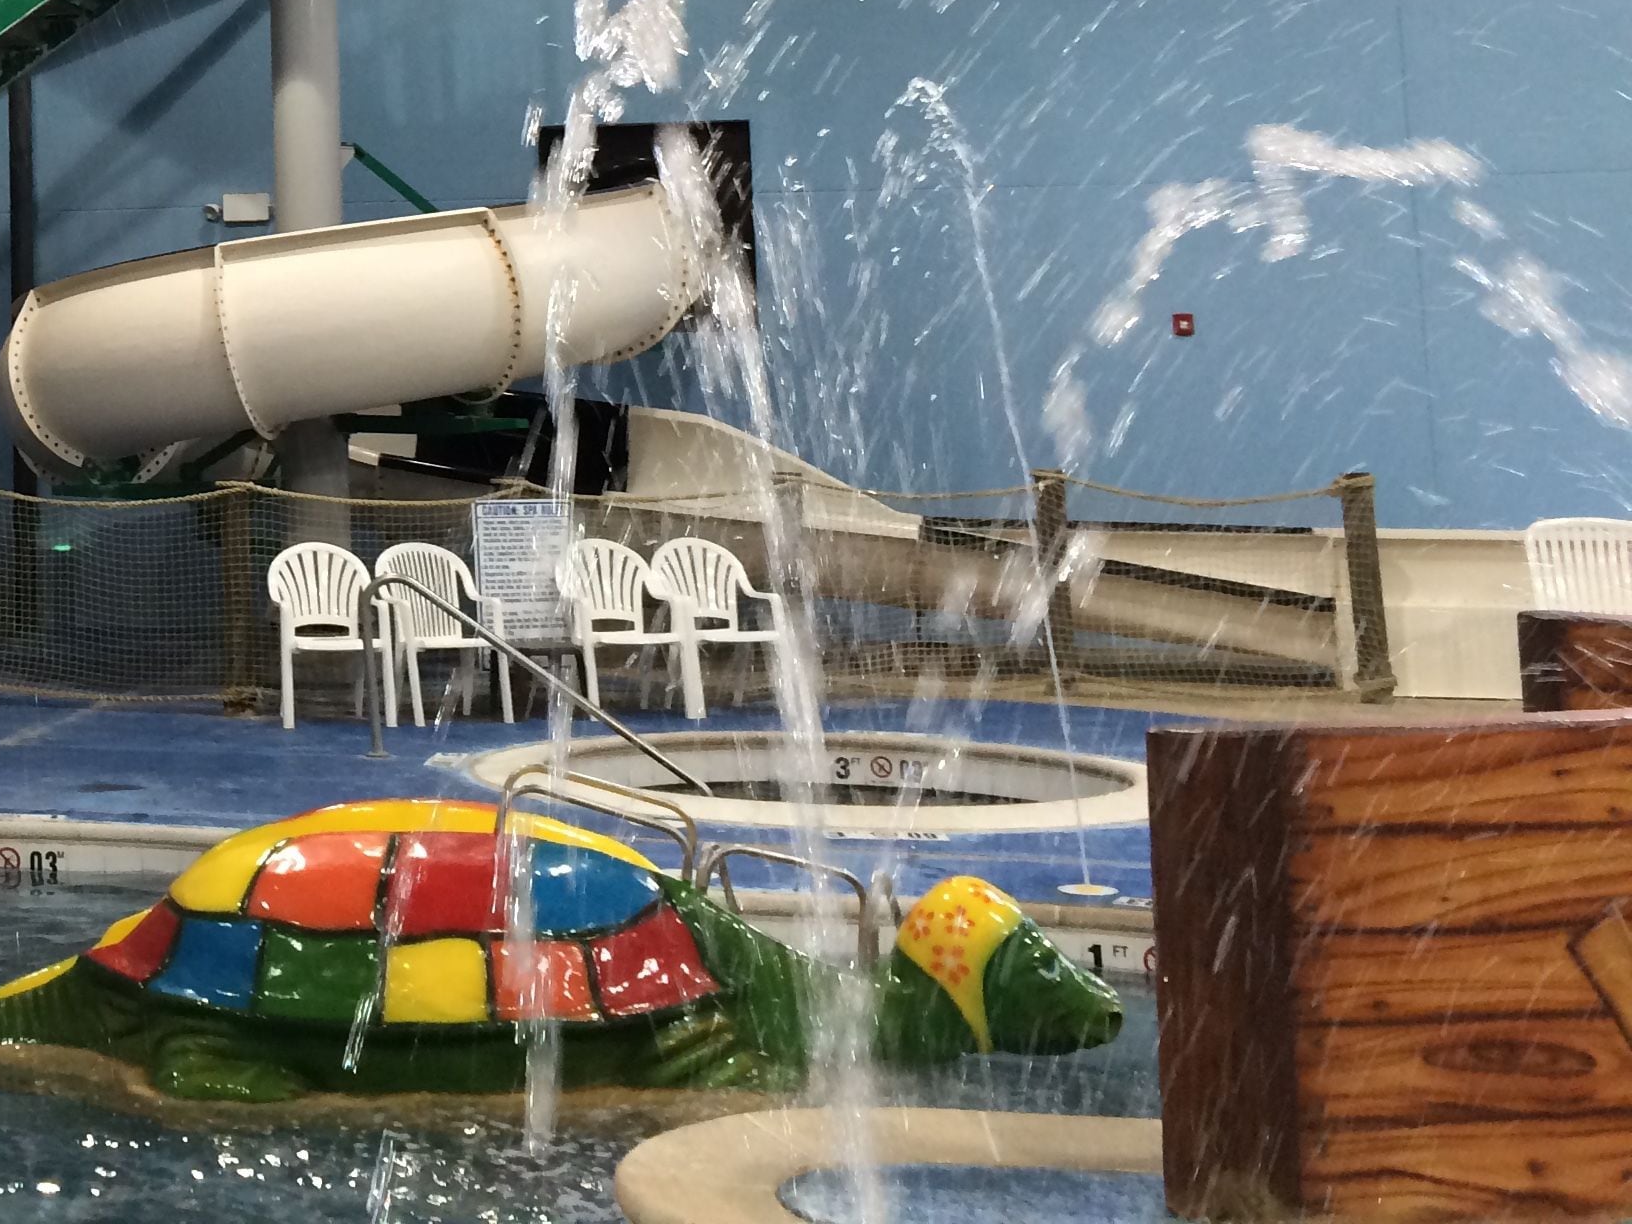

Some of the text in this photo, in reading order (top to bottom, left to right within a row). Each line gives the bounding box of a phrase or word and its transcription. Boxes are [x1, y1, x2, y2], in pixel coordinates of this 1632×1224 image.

[835, 757, 850, 779] 3
[1088, 944, 1128, 969] 1 FT
